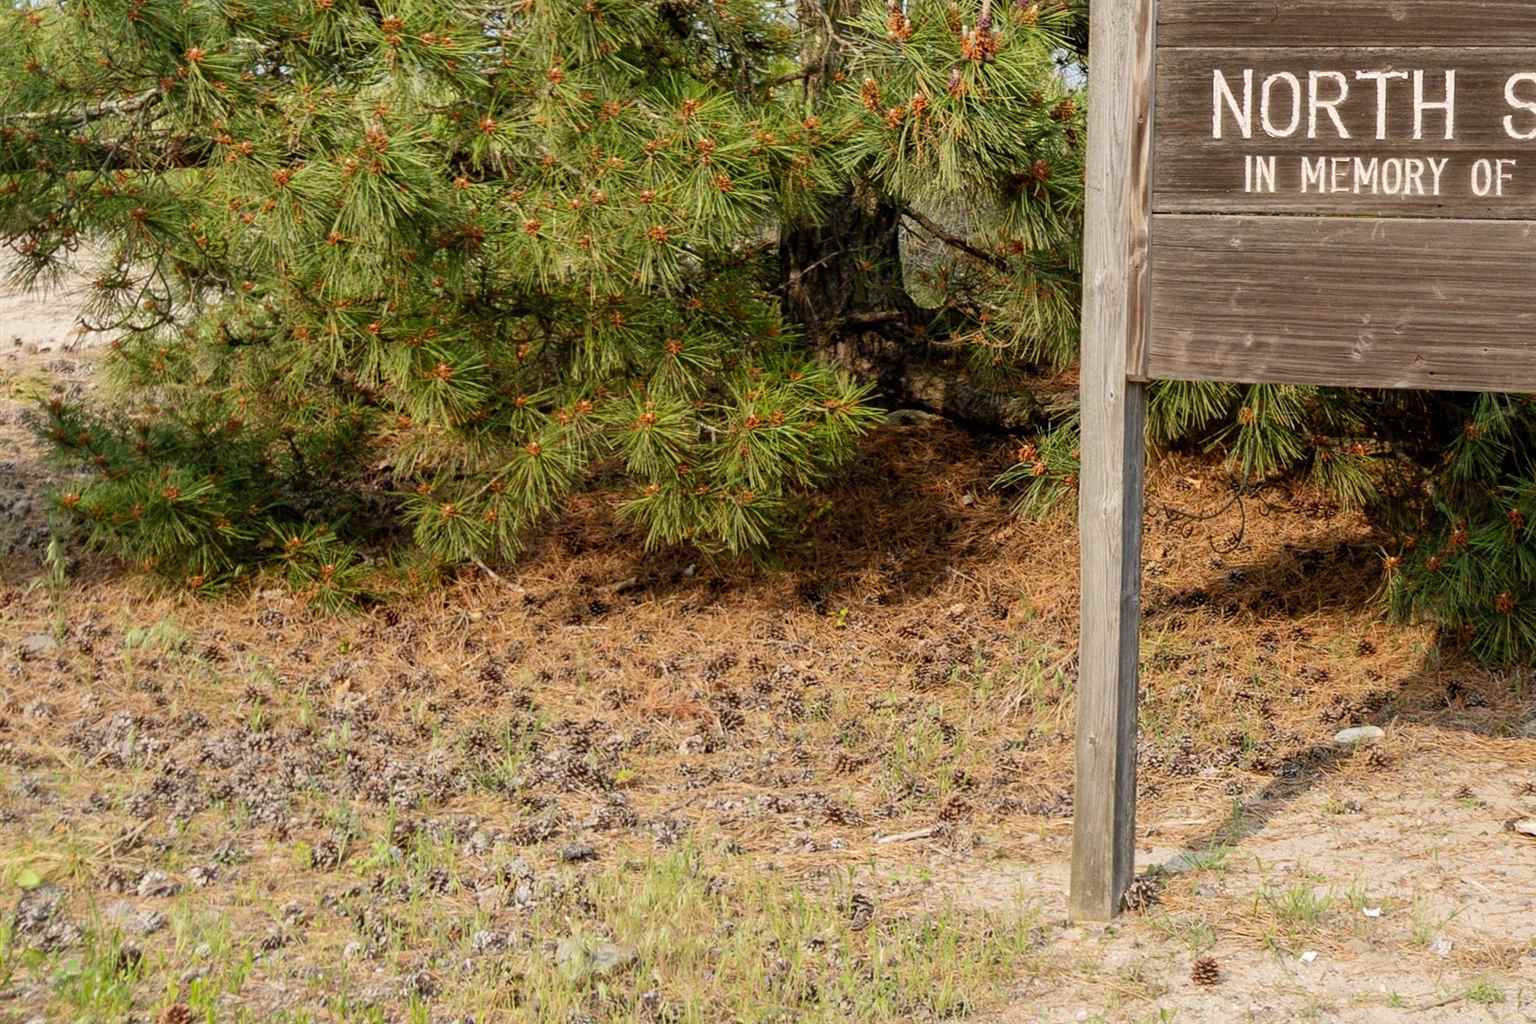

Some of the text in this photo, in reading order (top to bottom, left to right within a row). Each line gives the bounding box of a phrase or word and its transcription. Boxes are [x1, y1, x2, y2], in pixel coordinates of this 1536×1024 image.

[1212, 69, 1455, 141] NORTH
[1244, 155, 1277, 193] IN
[1300, 156, 1448, 197] MEMORY
[1470, 158, 1516, 197] OF
